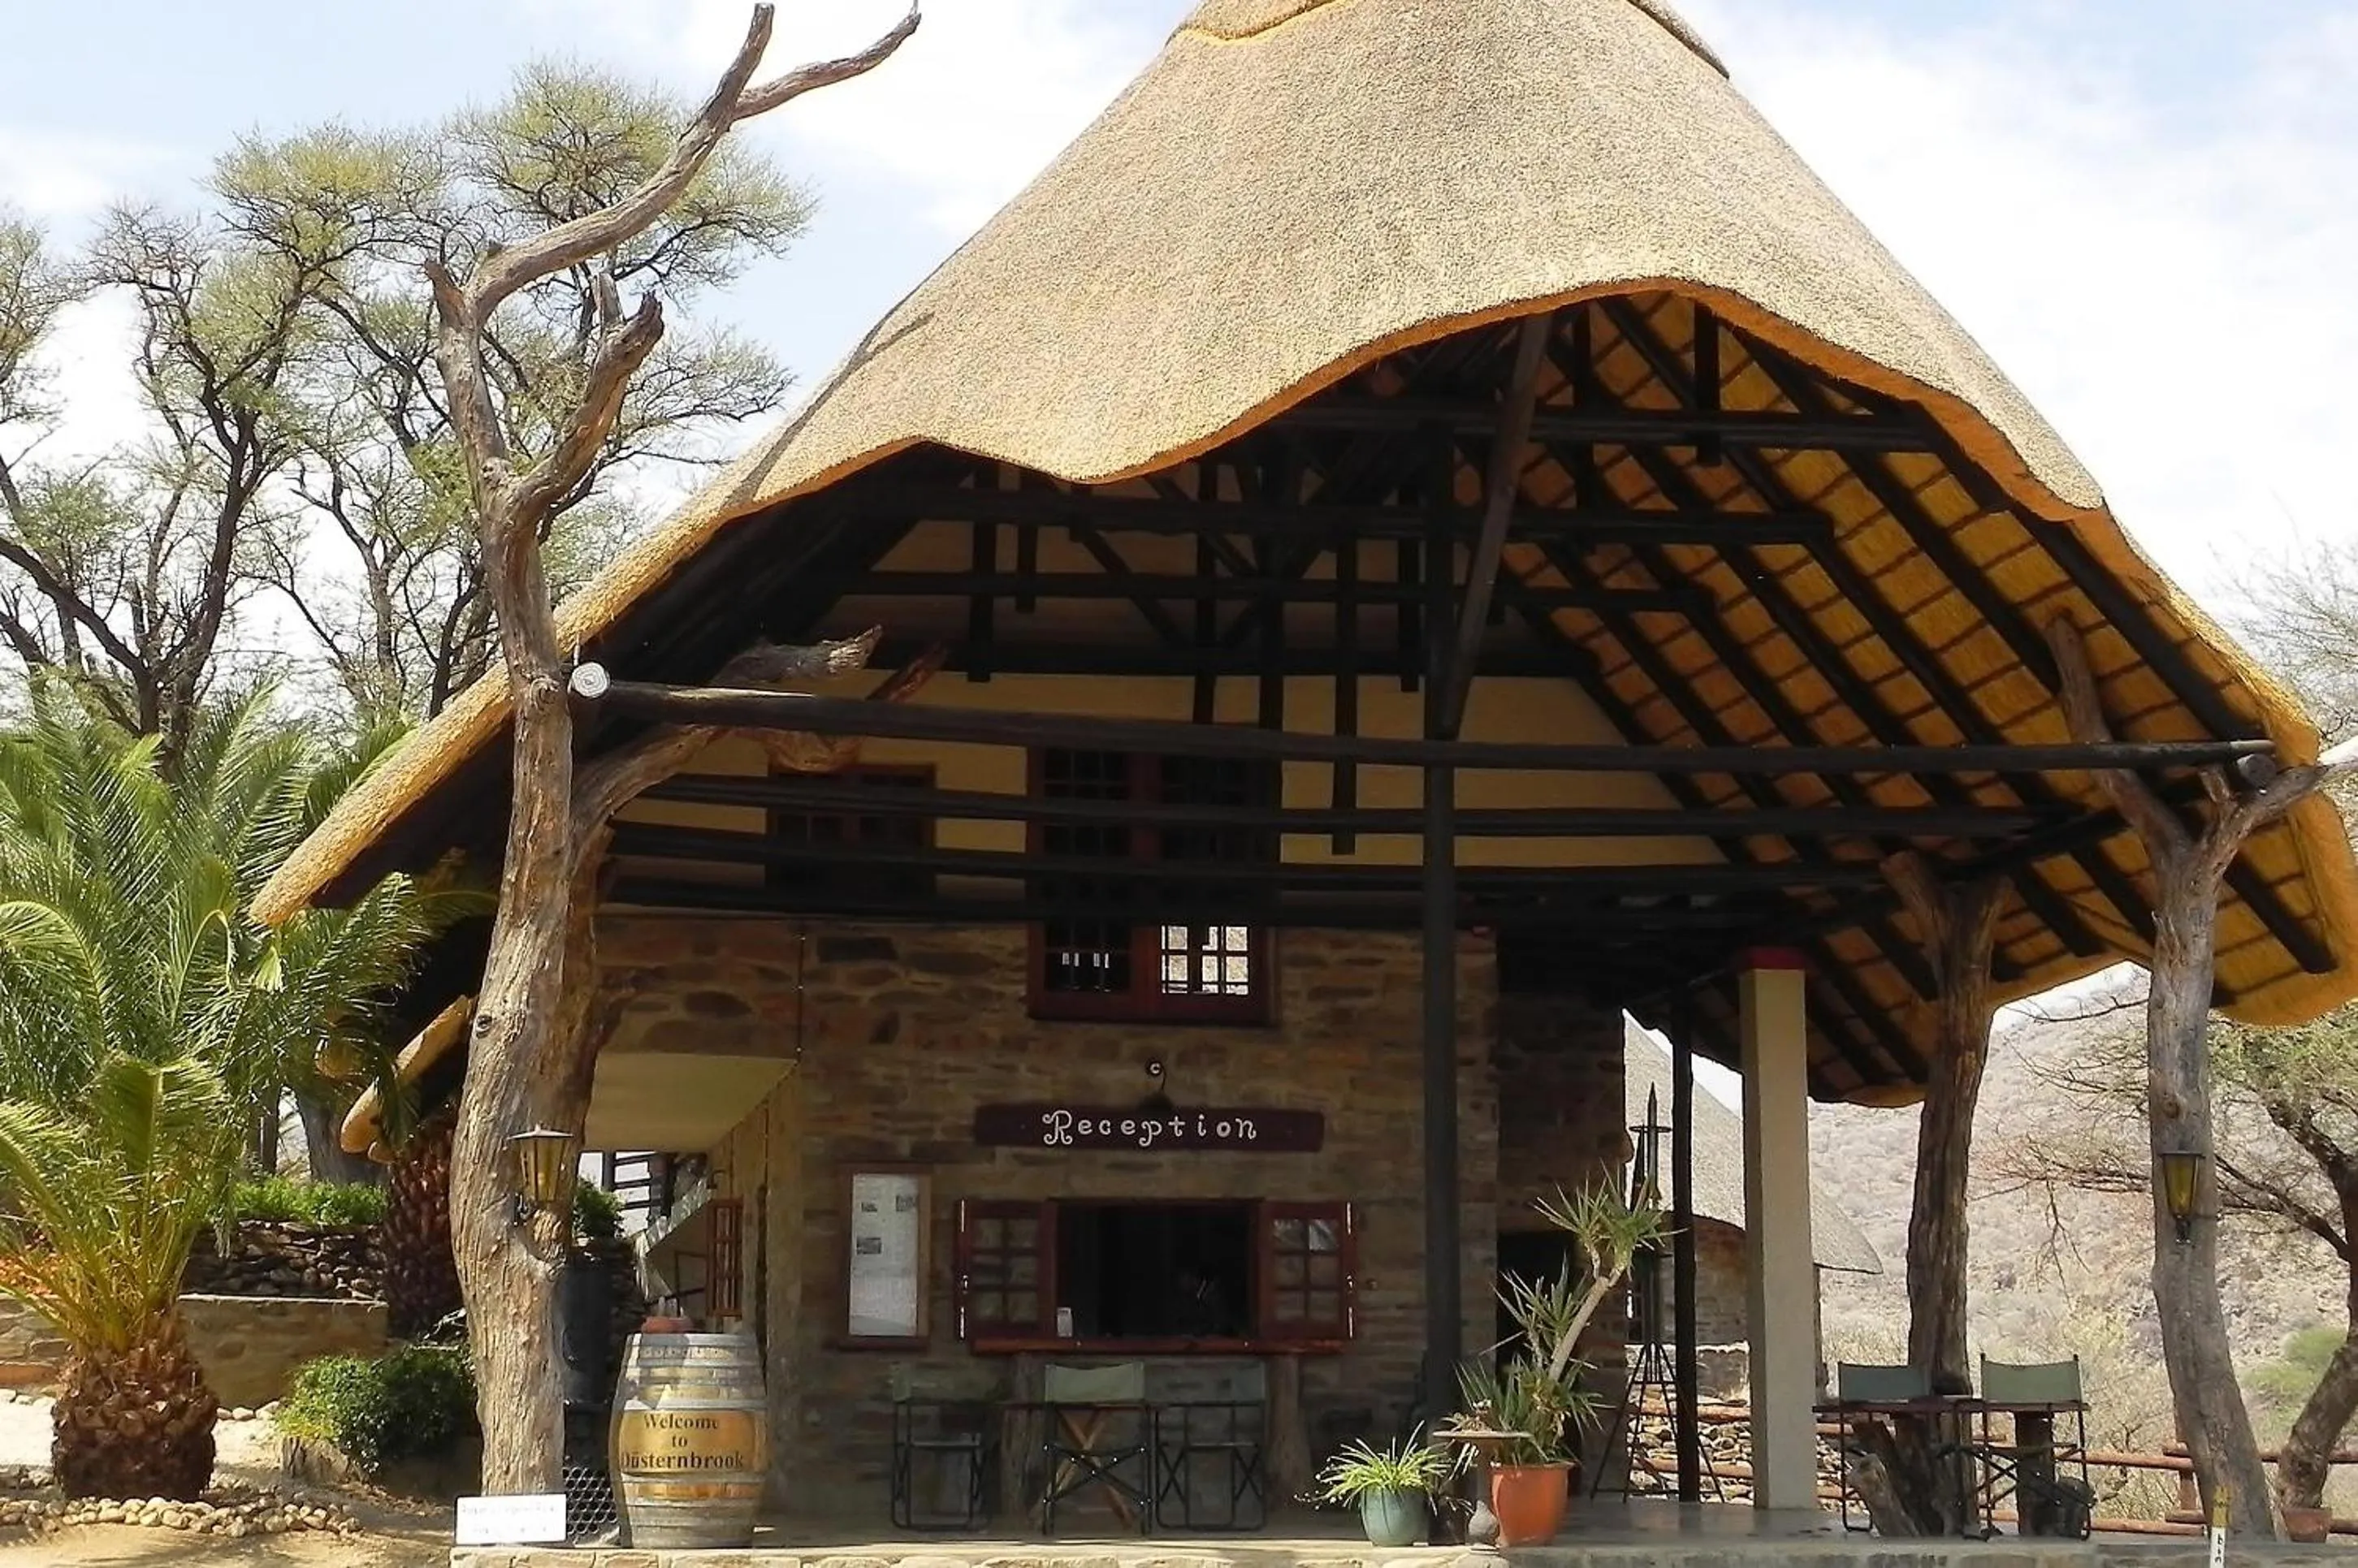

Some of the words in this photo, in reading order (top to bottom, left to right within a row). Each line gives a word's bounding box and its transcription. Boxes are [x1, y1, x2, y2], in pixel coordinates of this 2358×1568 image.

[1042, 1110, 1256, 1146] Reception
[644, 1413, 718, 1429] Welcome
[672, 1434, 688, 1448] to
